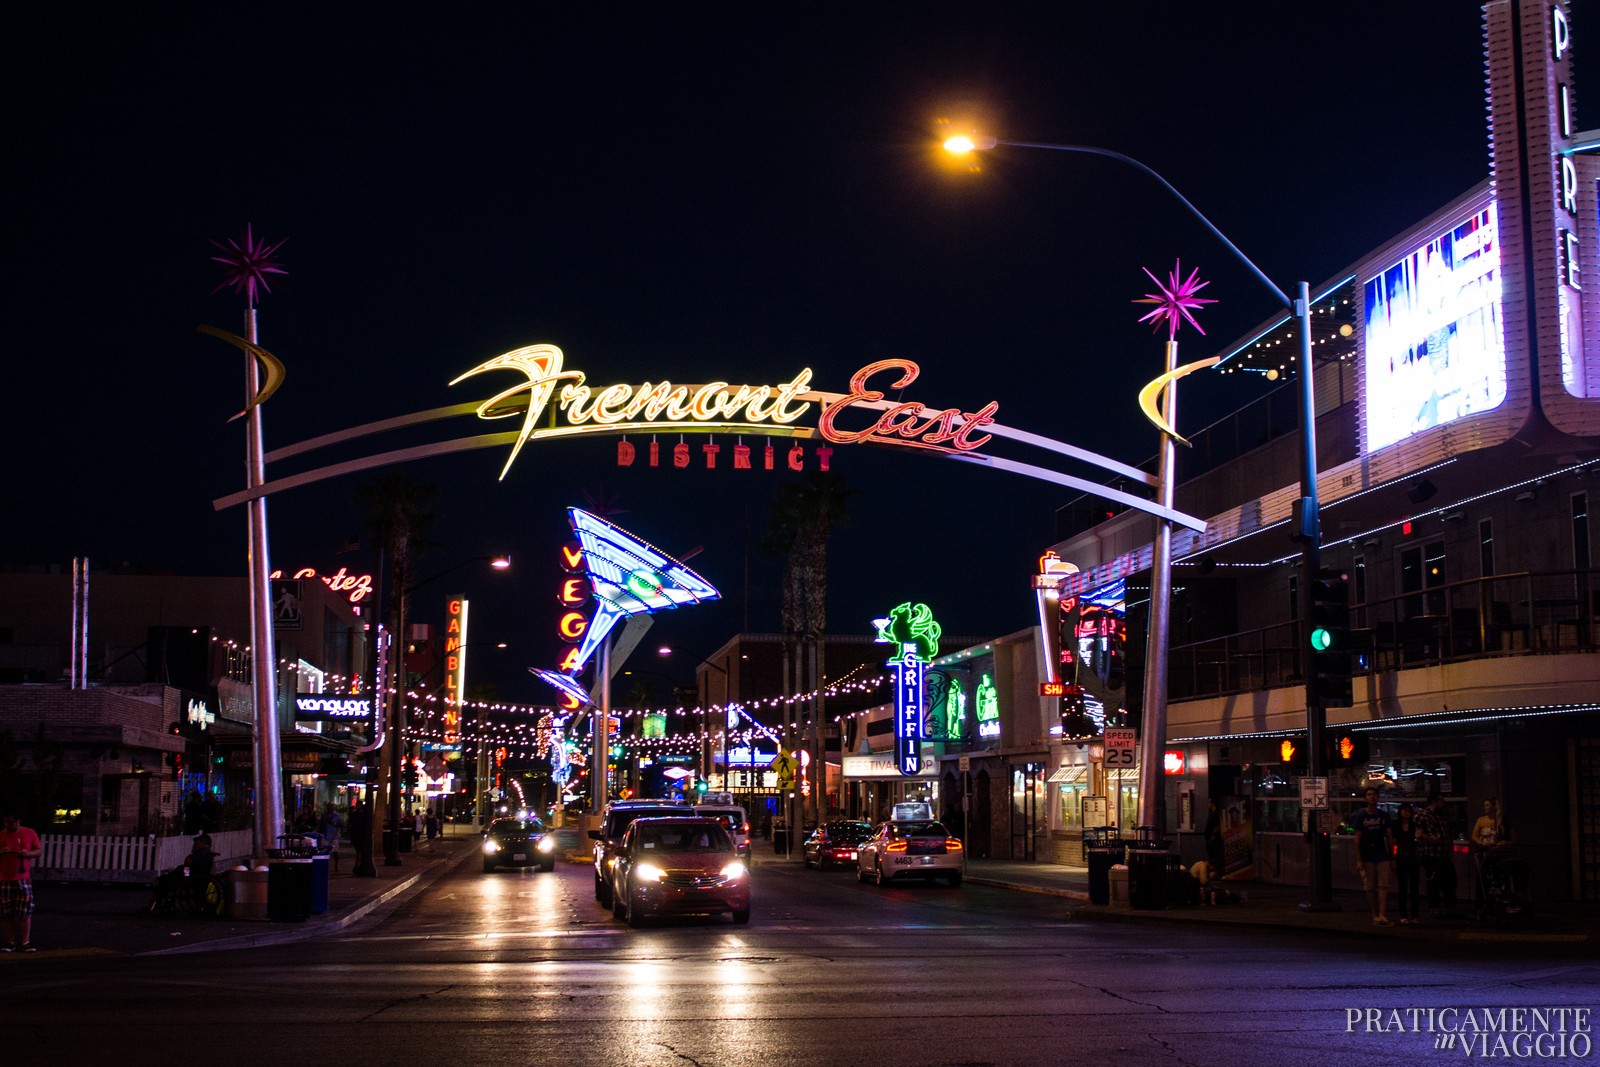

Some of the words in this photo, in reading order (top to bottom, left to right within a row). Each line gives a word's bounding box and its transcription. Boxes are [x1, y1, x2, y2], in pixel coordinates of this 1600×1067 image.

[448, 343, 812, 482] Fremont
[818, 358, 999, 455] East
[616, 440, 834, 473] DISTRICT
[560, 546, 589, 709] VEGAS
[444, 600, 461, 744] GAMBLING
[903, 653, 918, 772] GRIFFIN
[1106, 732, 1134, 740] SPEED
[1109, 740, 1130, 748] LIMIT
[1106, 748, 1133, 764] 25
[894, 856, 913, 865] 4463
